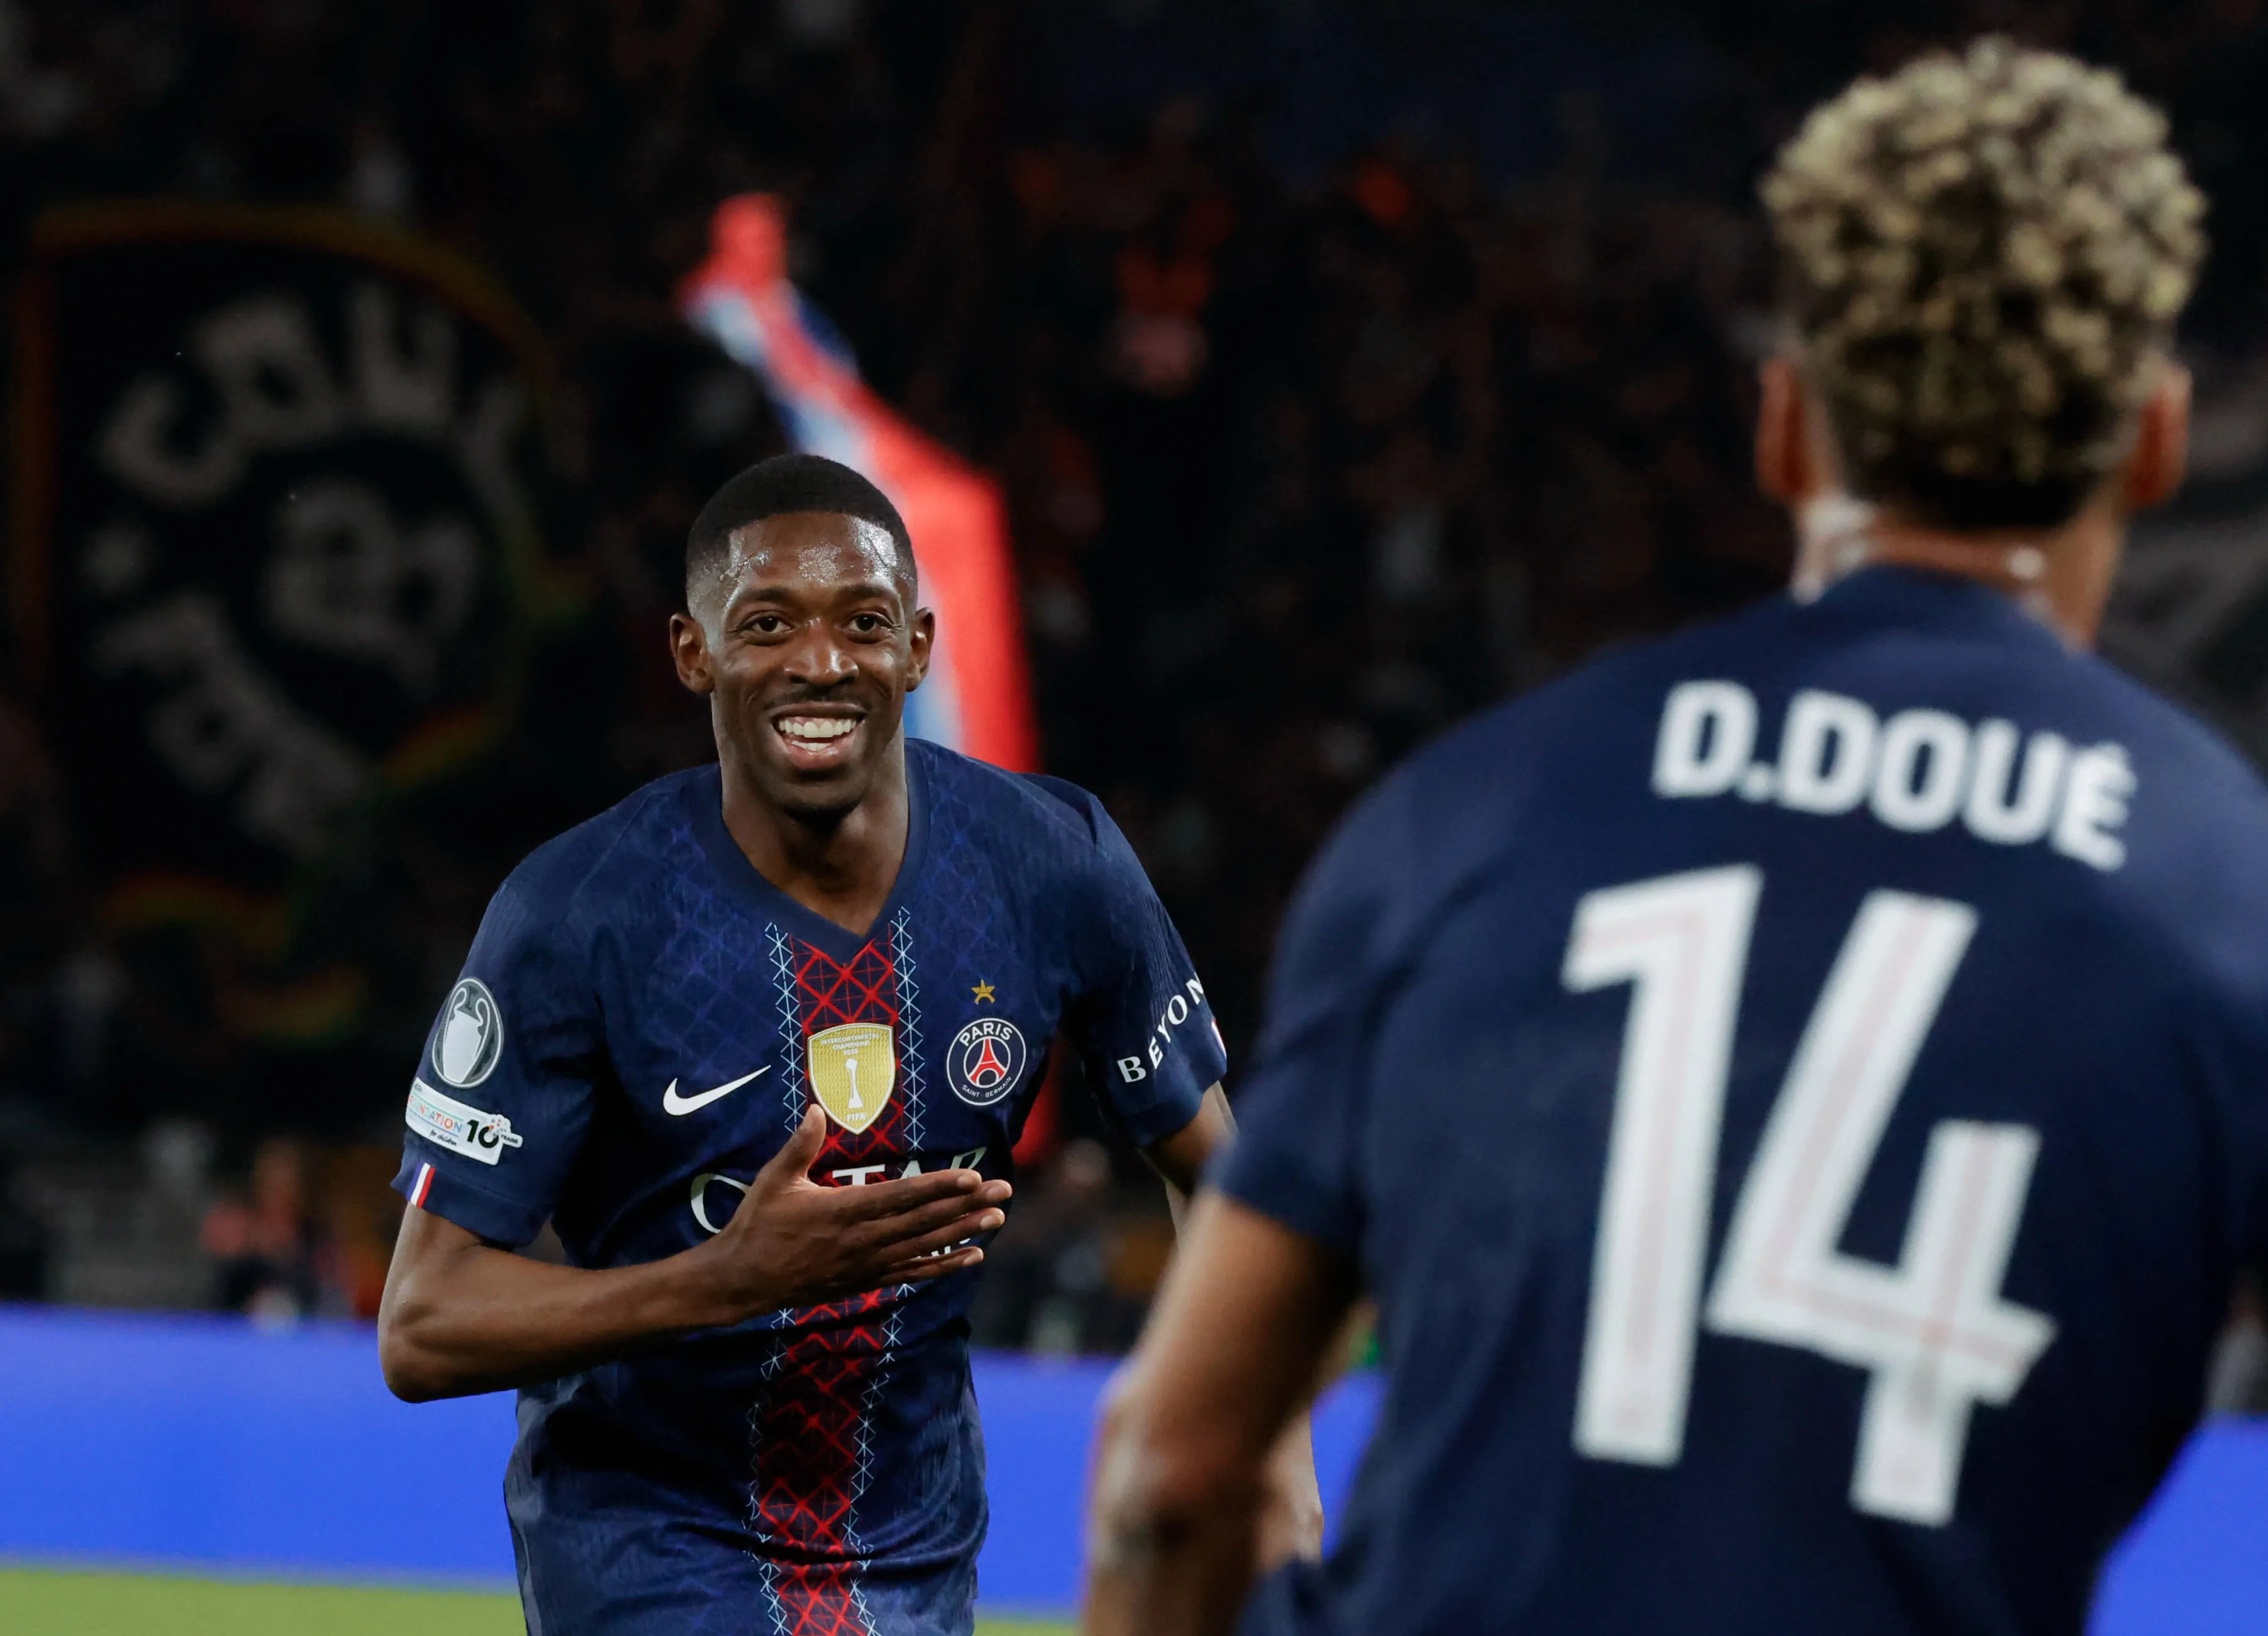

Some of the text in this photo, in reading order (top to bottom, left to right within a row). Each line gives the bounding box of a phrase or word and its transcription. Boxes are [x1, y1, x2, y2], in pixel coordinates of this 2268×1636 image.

[1652, 679, 2137, 872] D.DOUÉ
[820, 1033, 879, 1045] INTERCONTINENTAL
[959, 1021, 1013, 1047] PARIS
[961, 1076, 1013, 1098] SAINT GERMAIN
[846, 1112, 867, 1123] FIFA
[467, 1119, 499, 1149] 10
[501, 1133, 518, 1144] YEARS
[1561, 862, 2059, 1527] 14
